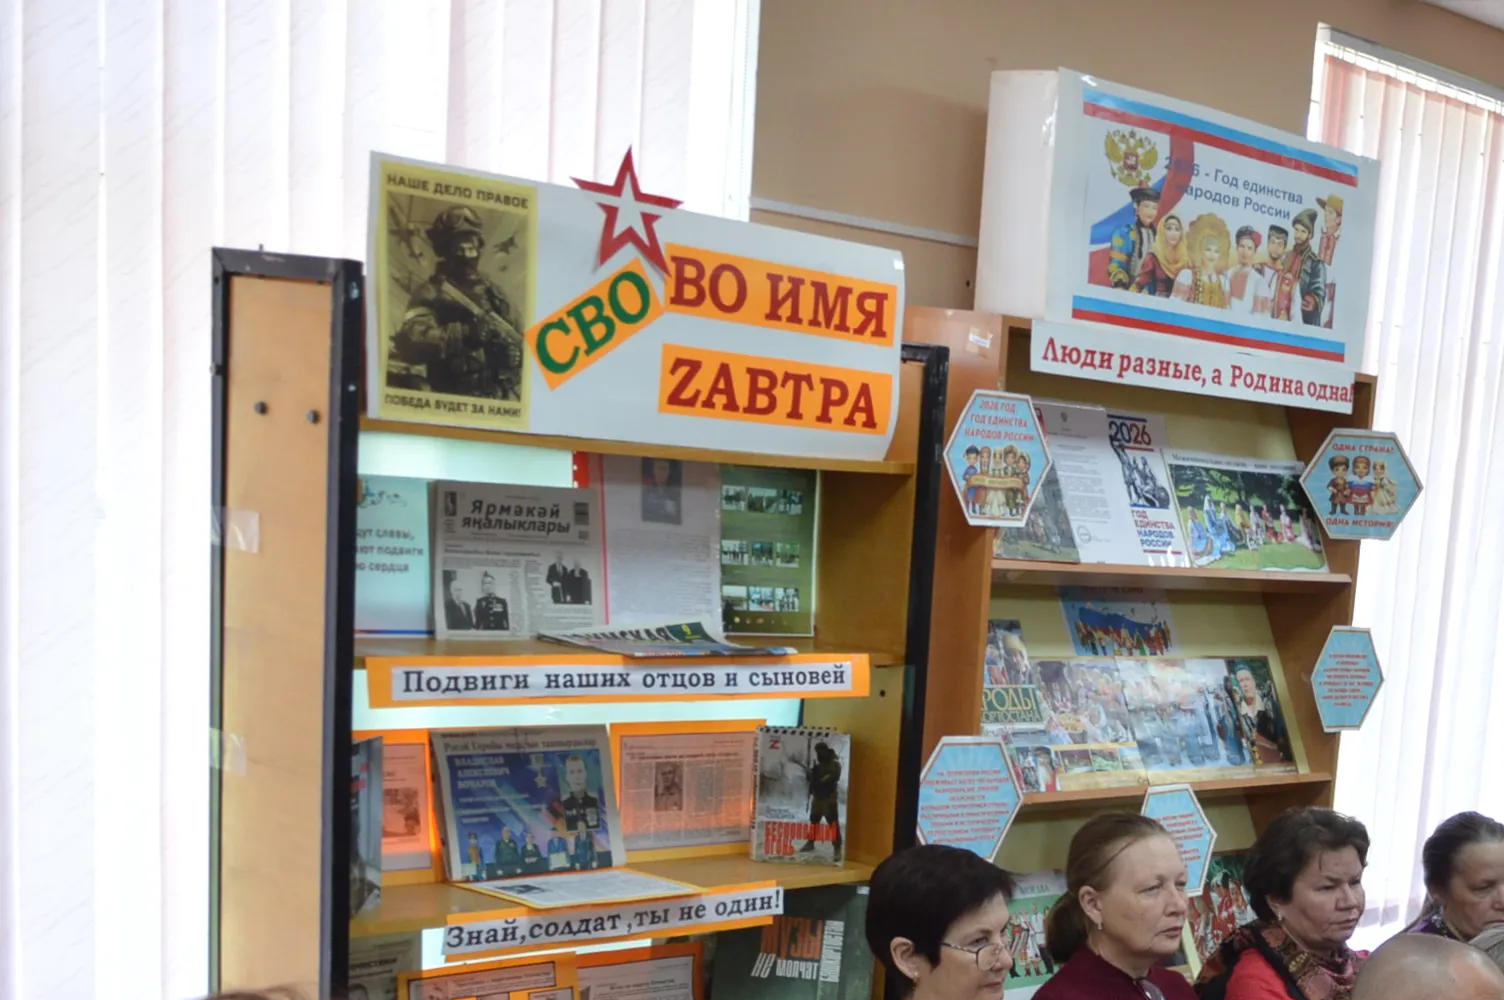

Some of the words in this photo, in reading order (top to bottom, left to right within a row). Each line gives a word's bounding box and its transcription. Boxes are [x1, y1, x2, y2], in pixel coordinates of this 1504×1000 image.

[387, 174, 429, 191] НАШЕ
[434, 183, 472, 198] ДЕЛО
[476, 190, 529, 209] ПРАВОЕ
[1214, 168, 1239, 189] Год
[1243, 179, 1303, 204] единства
[1244, 197, 1291, 220] России
[669, 255, 748, 314] ВО
[764, 271, 890, 340] ИМЯ
[535, 269, 652, 374] СВО
[1041, 336, 1113, 371] Люди
[1117, 345, 1208, 384] разные,
[1211, 367, 1223, 386] а
[1230, 364, 1305, 399] Родина
[1306, 378, 1355, 404] одна!
[385, 394, 431, 410] ПОБЕДА
[434, 400, 468, 413] БУДЕТ
[471, 403, 485, 414] ЗА
[1000, 402, 1017, 413] ГОД
[971, 413, 986, 424] ГОД
[988, 415, 1028, 428] ЕДИНСТВА
[965, 427, 1002, 439] НАРОДОВ
[1003, 431, 1035, 441] РОССИИ
[1108, 421, 1152, 446] 2026
[1332, 443, 1356, 452] ОДНА
[471, 500, 560, 519] Ярмәкәй
[1131, 509, 1149, 520] ГОД
[1134, 519, 1175, 530] ЕДИНСТВА
[1326, 518, 1349, 526] ОДНА
[1137, 529, 1175, 539] НАРОДОВ
[402, 669, 531, 695] Подвиги
[545, 666, 630, 689] наших
[642, 666, 716, 690] отцов
[725, 669, 738, 686] и
[749, 663, 845, 687] сыновей
[982, 711, 1043, 723] ОРТОСТАНА
[679, 902, 706, 921] не
[715, 887, 781, 917] один!
